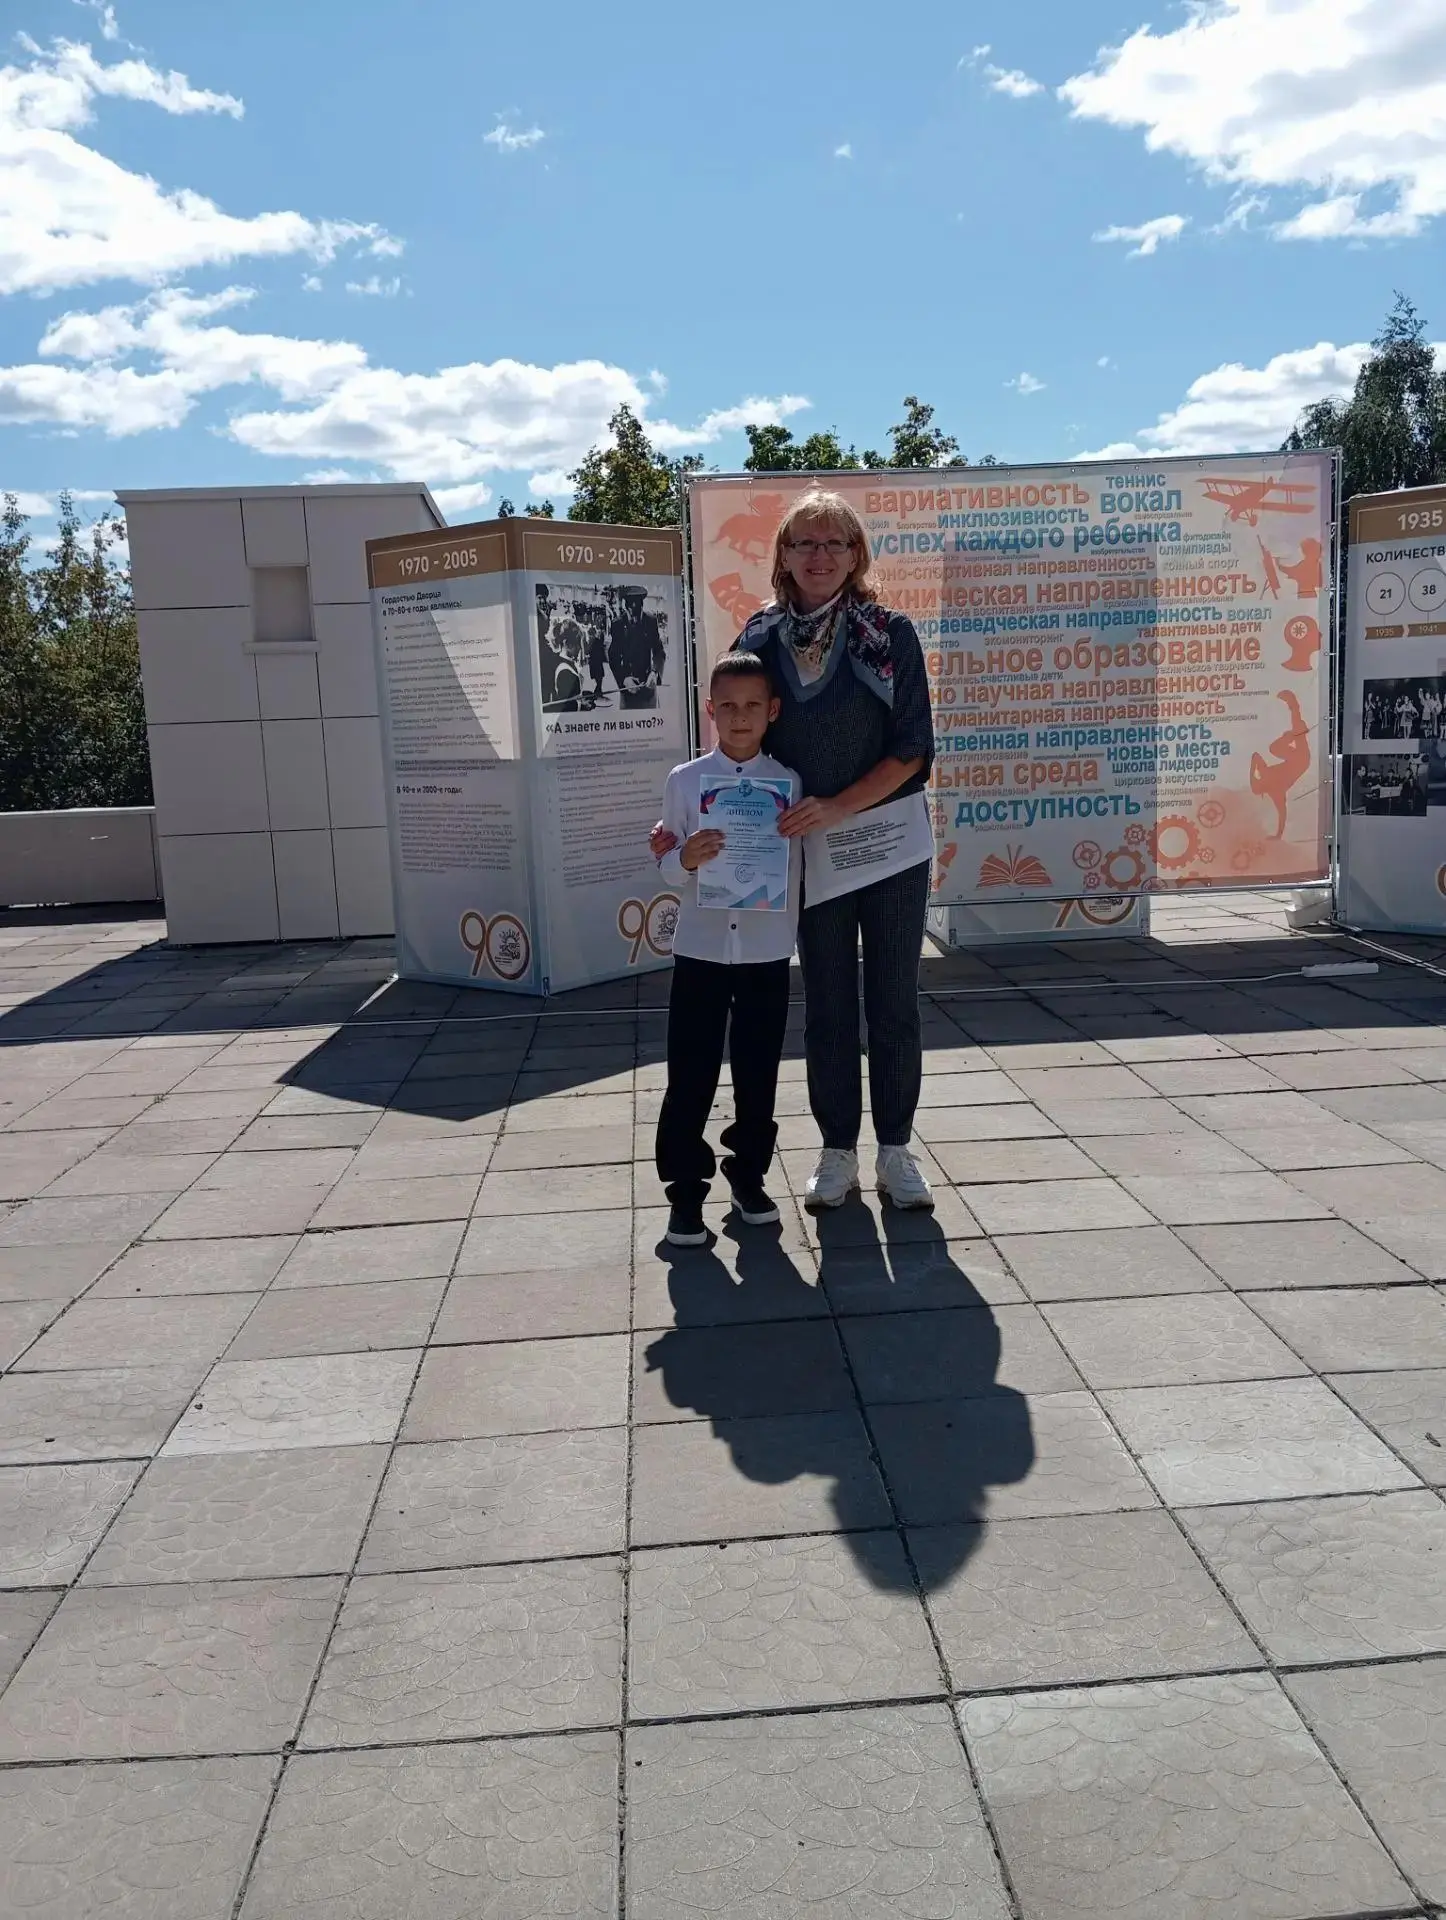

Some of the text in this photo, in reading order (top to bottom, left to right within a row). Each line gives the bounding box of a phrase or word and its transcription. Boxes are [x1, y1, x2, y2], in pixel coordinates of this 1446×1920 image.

[1105, 473, 1166, 489] теннис
[865, 483, 1090, 519] вариативность
[1100, 490, 1182, 514] вокал
[938, 508, 1090, 529] инклюзивность
[1397, 509, 1443, 530] 1935
[870, 517, 1182, 560] успех каждого ребенка
[557, 545, 594, 564] 1970
[609, 548, 645, 566] 2005
[1159, 542, 1232, 557] олимпиады
[1366, 545, 1446, 564] КОЛИЧЕСТВ
[399, 556, 429, 577] 1970
[443, 548, 478, 570] 2005
[1016, 556, 1155, 578] направленность
[1163, 558, 1240, 571] конный спорт
[416, 590, 442, 601] Дворца
[1037, 573, 1257, 608] направленность
[1380, 588, 1392, 599] 21
[1422, 585, 1436, 595] 38
[412, 605, 430, 615] годы
[974, 604, 1035, 617] воспитание
[1066, 606, 1222, 630] направленность
[1226, 607, 1272, 621] вокал
[1137, 621, 1262, 639] талантливые дети
[1375, 628, 1394, 637] 1935
[1420, 624, 1438, 632] 1941
[984, 633, 1065, 647] экомониторинг
[1053, 636, 1261, 677] образование
[1156, 661, 1265, 675] техническое творчество
[981, 671, 1064, 685] счастливые дети
[963, 682, 1055, 708] научная
[1062, 673, 1246, 702] направленность
[1071, 700, 1226, 725] направленность
[565, 721, 600, 733] знаете
[603, 720, 617, 731] ли
[619, 719, 634, 730] вы
[636, 717, 664, 729] что?»
[1036, 724, 1213, 751] направленность
[1107, 744, 1170, 762] новые
[1175, 740, 1231, 758] места
[1112, 757, 1219, 774] школа лидеров
[1013, 760, 1098, 790] среда
[1114, 773, 1216, 788] цирковое искусство
[955, 794, 1141, 828] доступность
[1144, 798, 1193, 810] флористика
[460, 911, 530, 980] 90
